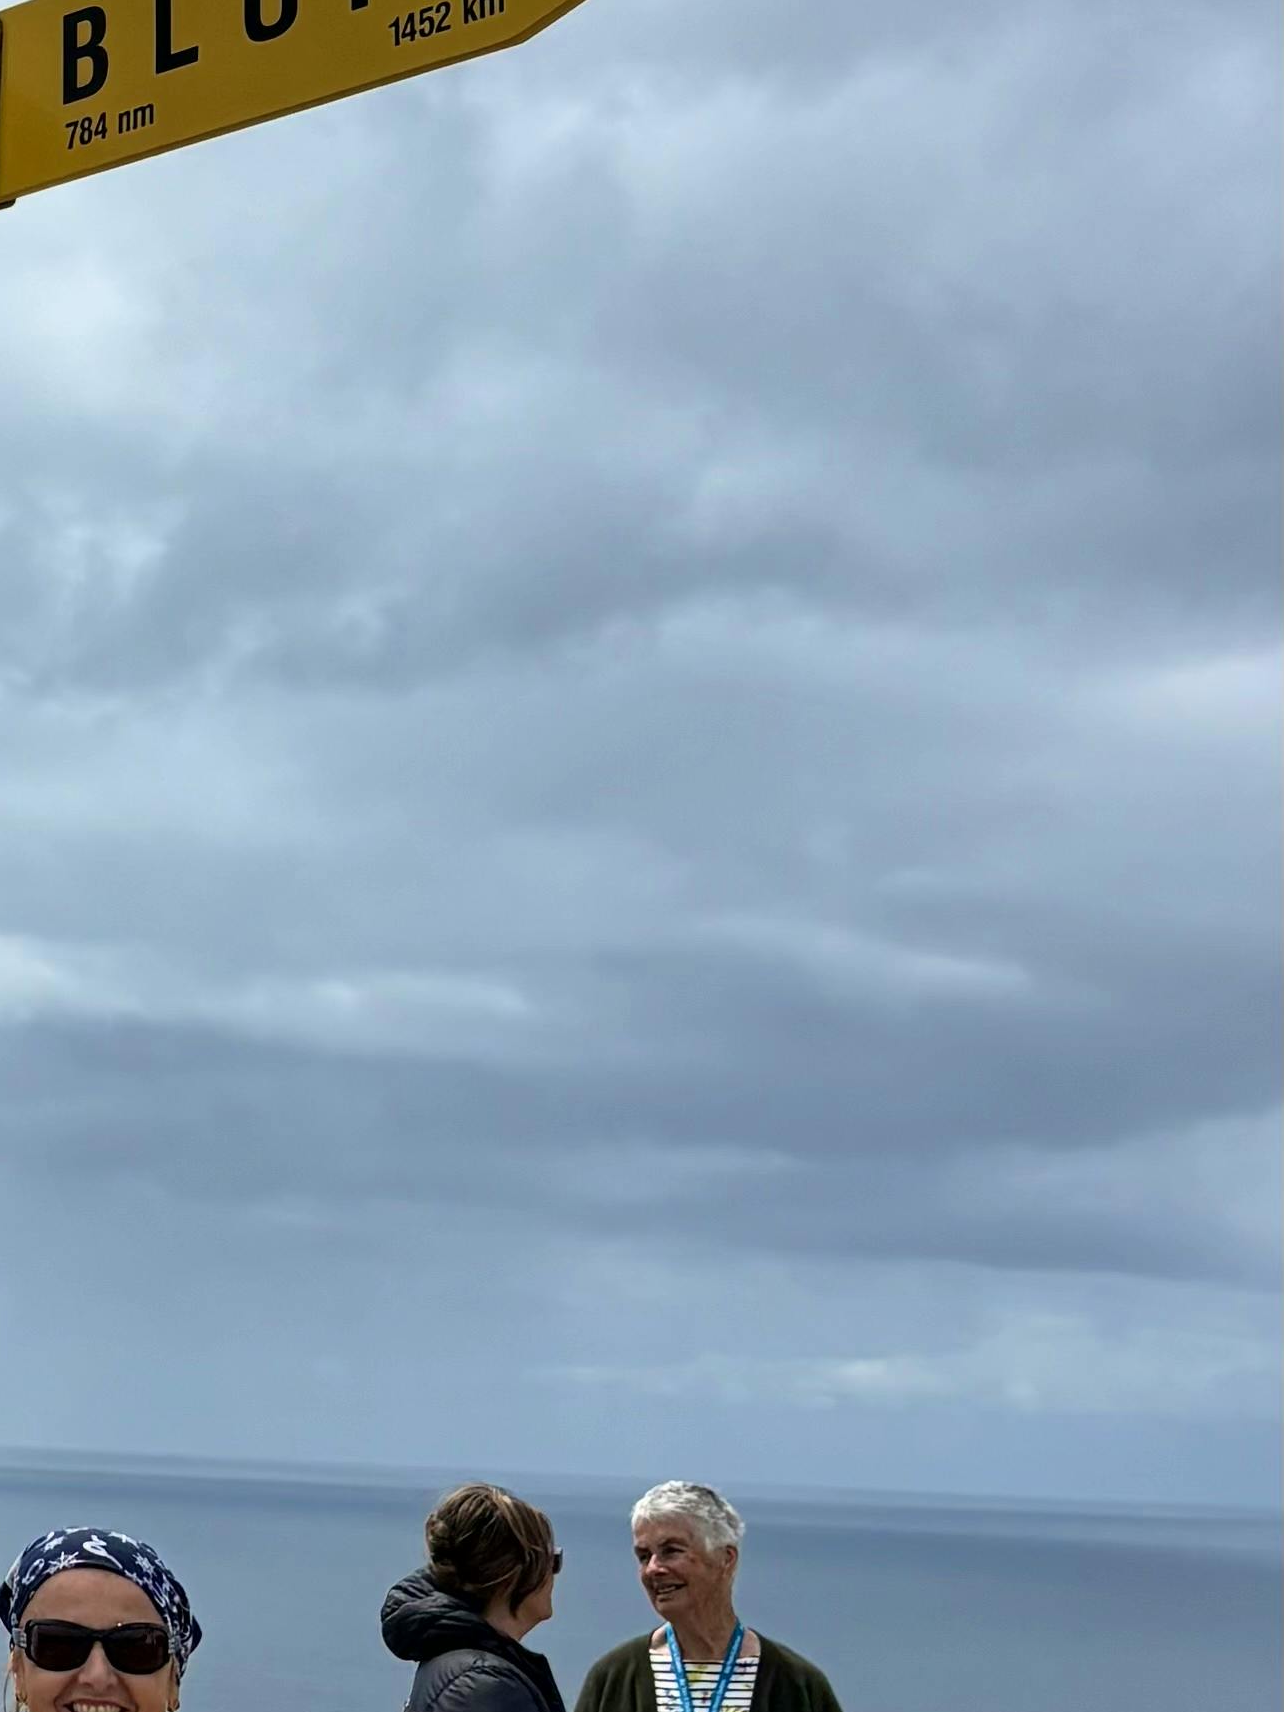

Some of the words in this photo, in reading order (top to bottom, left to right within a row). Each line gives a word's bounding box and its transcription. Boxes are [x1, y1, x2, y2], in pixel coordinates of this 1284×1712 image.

[386, 0, 453, 49] 1452
[64, 110, 109, 151] 784
[117, 102, 156, 136] nm
